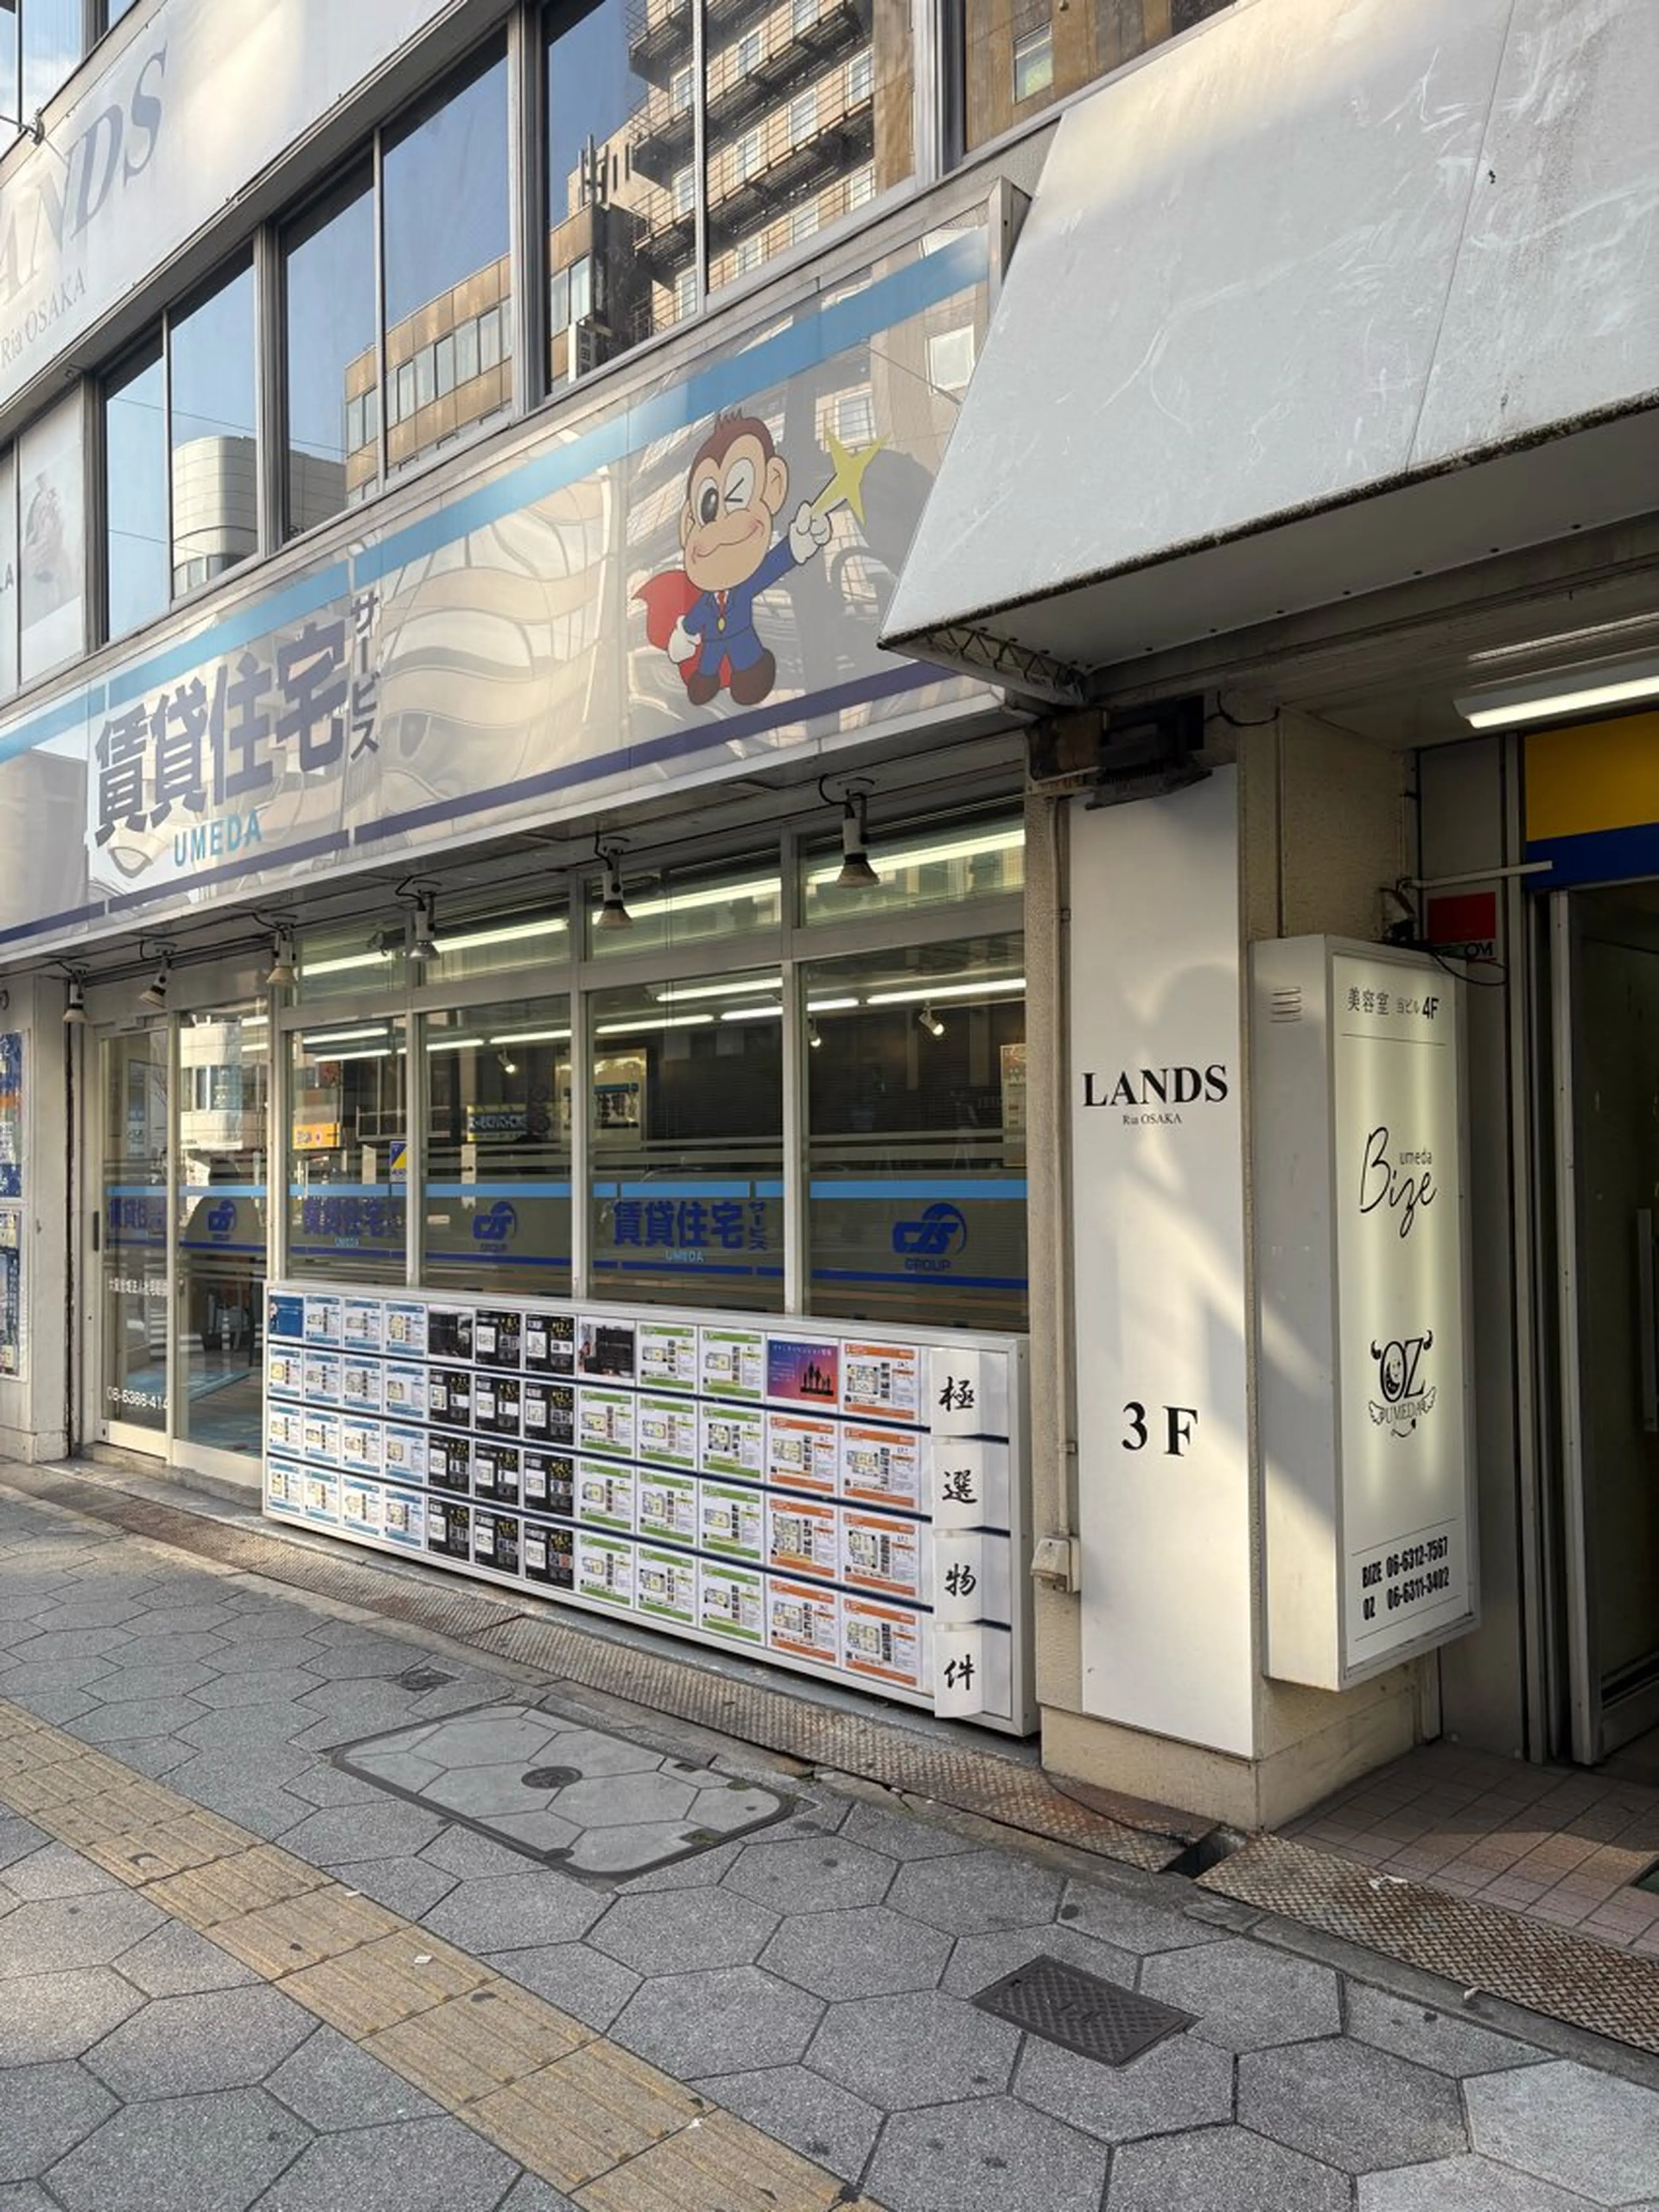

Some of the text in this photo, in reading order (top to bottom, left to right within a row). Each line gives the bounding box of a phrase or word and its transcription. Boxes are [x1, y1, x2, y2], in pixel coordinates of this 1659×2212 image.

[25, 268, 86, 343] OSAKA
[95, 619, 346, 847] 賃貸住宅
[174, 810, 263, 867] UMEDA
[1348, 987, 1389, 1015] 美容室
[1422, 996, 1439, 1020] 4F
[1082, 1065, 1228, 1106] LANDS
[1122, 1113, 1182, 1125] Ria OSAKA
[1399, 1148, 1432, 1165] umeda
[613, 1201, 744, 1249] 賃貸住宅
[1380, 1338, 1426, 1403] OZ
[1363, 1560, 1382, 1589] BIZE
[1363, 1596, 1375, 1621] OZ
